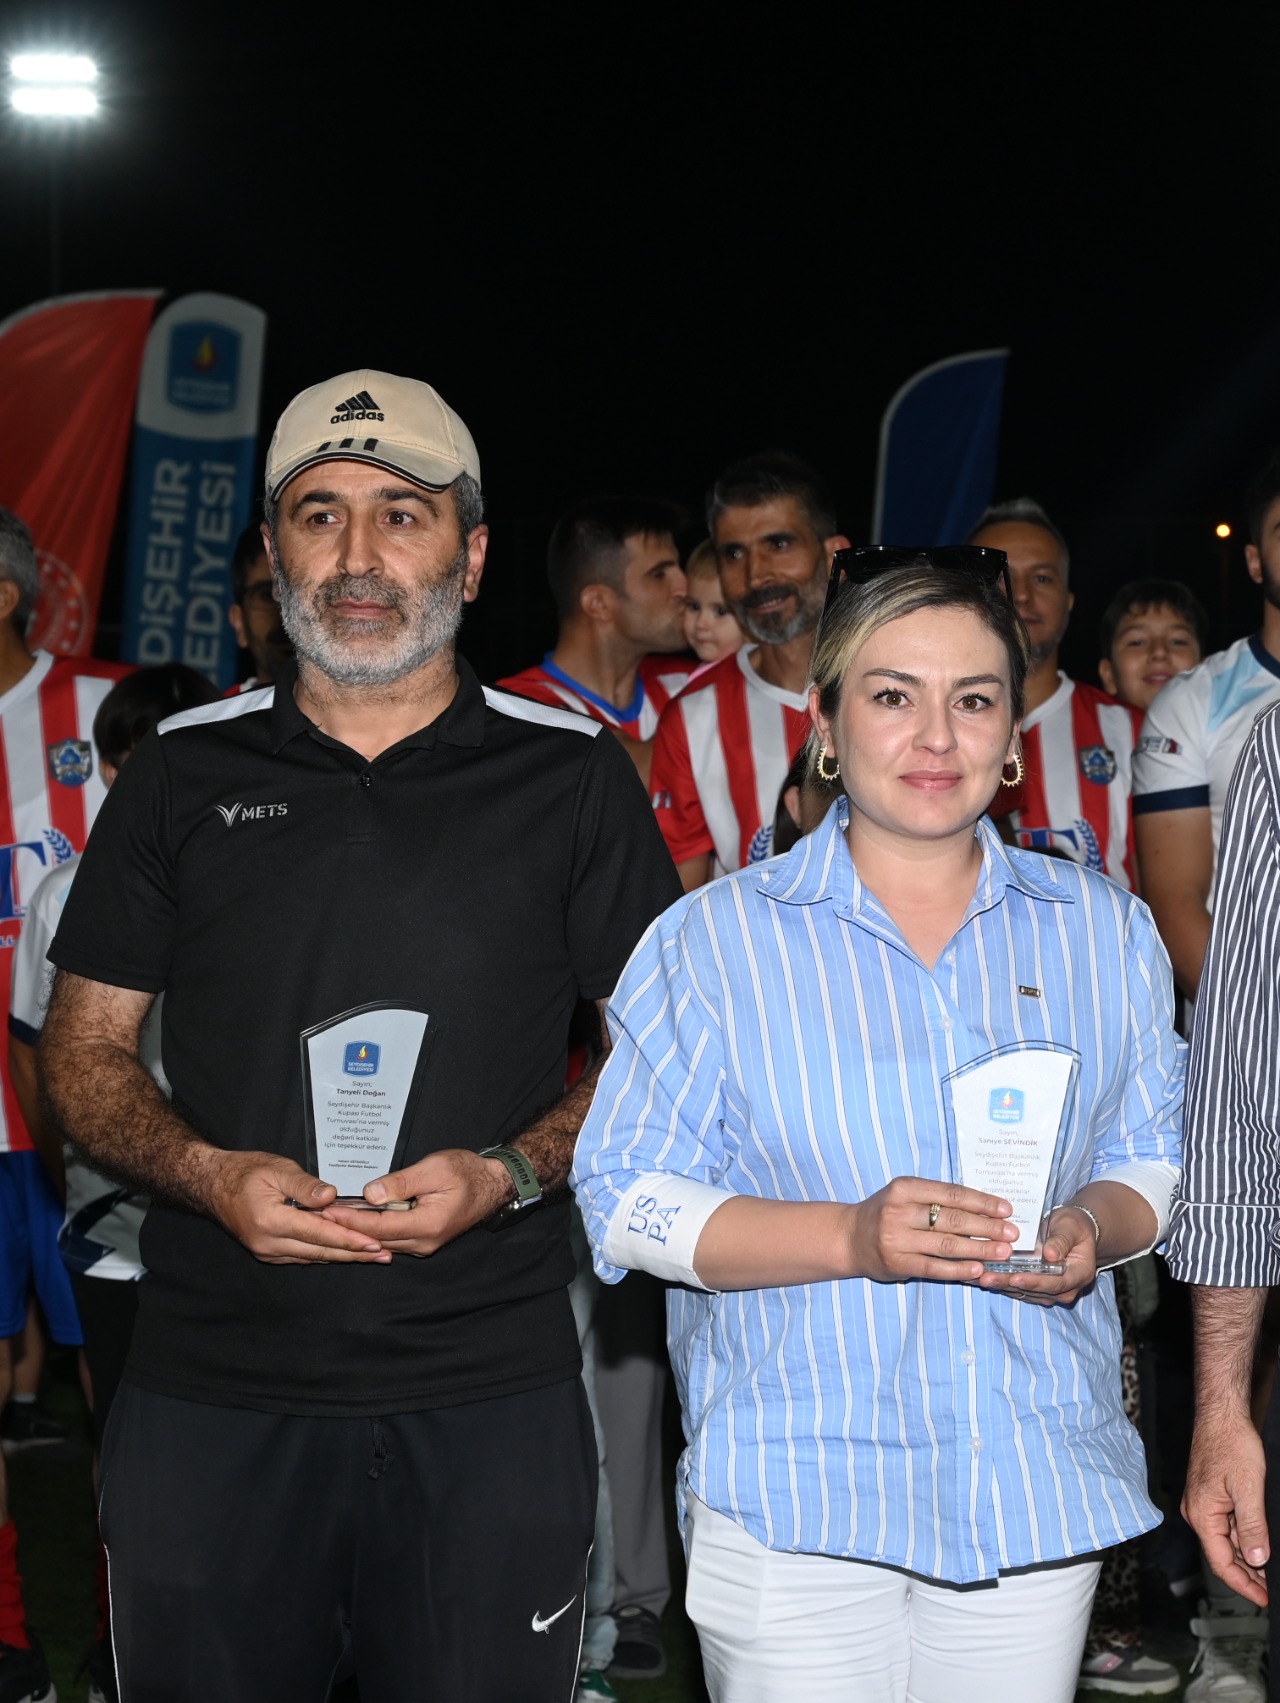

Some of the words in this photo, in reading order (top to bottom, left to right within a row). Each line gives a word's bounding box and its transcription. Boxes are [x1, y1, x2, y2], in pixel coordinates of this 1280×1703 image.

[330, 409, 385, 424] adidas
[241, 803, 288, 821] METS
[336, 1088, 362, 1096] Tanyeli
[362, 1089, 386, 1098] Doğan
[978, 1137, 1003, 1146] Saniye
[1003, 1137, 1039, 1147] SEVİNDİK
[628, 1194, 658, 1234] US
[647, 1205, 682, 1246] PA
